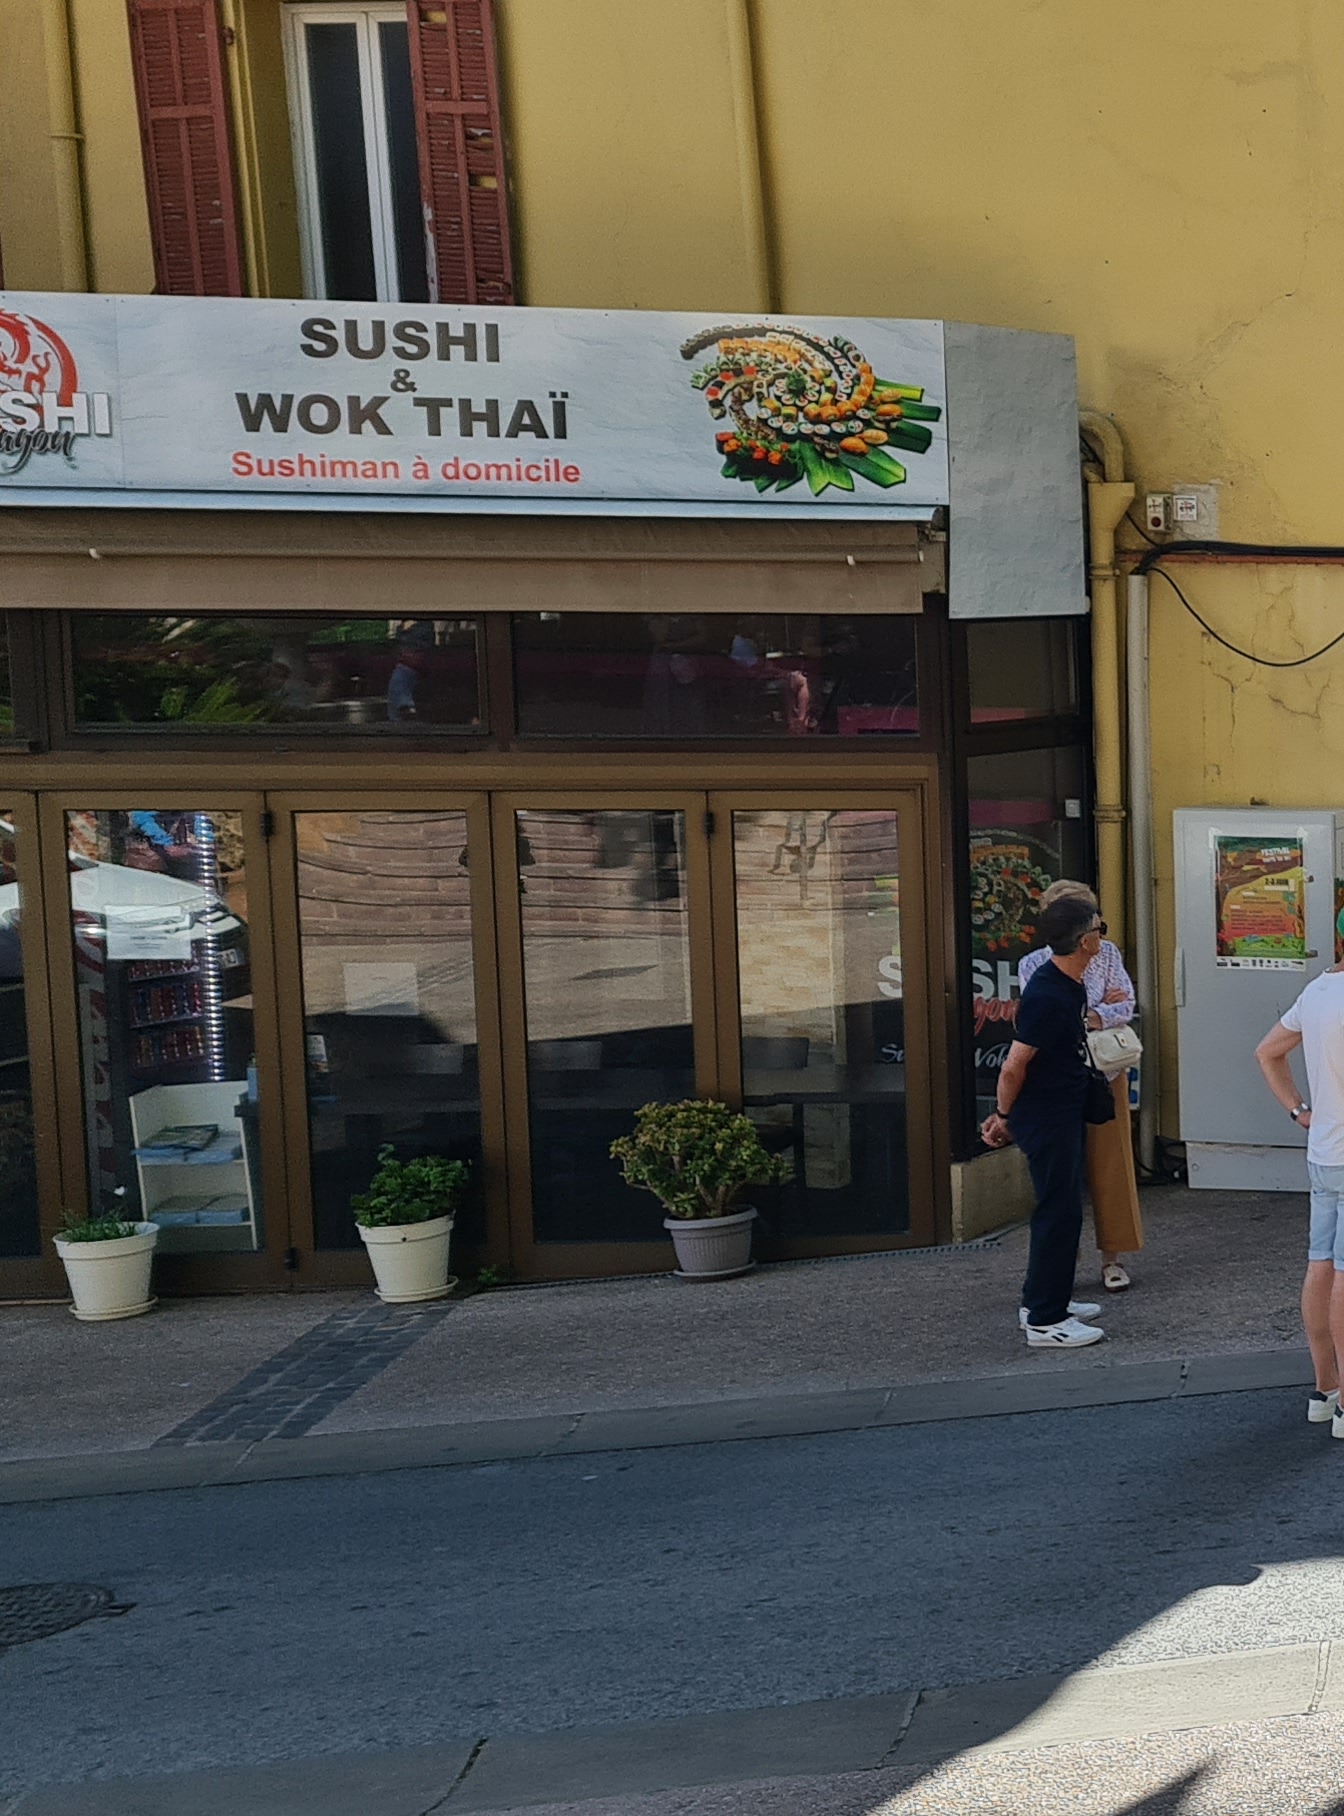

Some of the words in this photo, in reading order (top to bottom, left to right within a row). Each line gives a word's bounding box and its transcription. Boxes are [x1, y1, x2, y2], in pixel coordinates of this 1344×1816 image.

[300, 317, 500, 363] SUSHI
[390, 368, 417, 393] &
[235, 392, 394, 437] WOK
[413, 390, 569, 440] THAÏ
[231, 451, 400, 480] Sushiman
[411, 456, 431, 481] à
[441, 457, 581, 484] domicile
